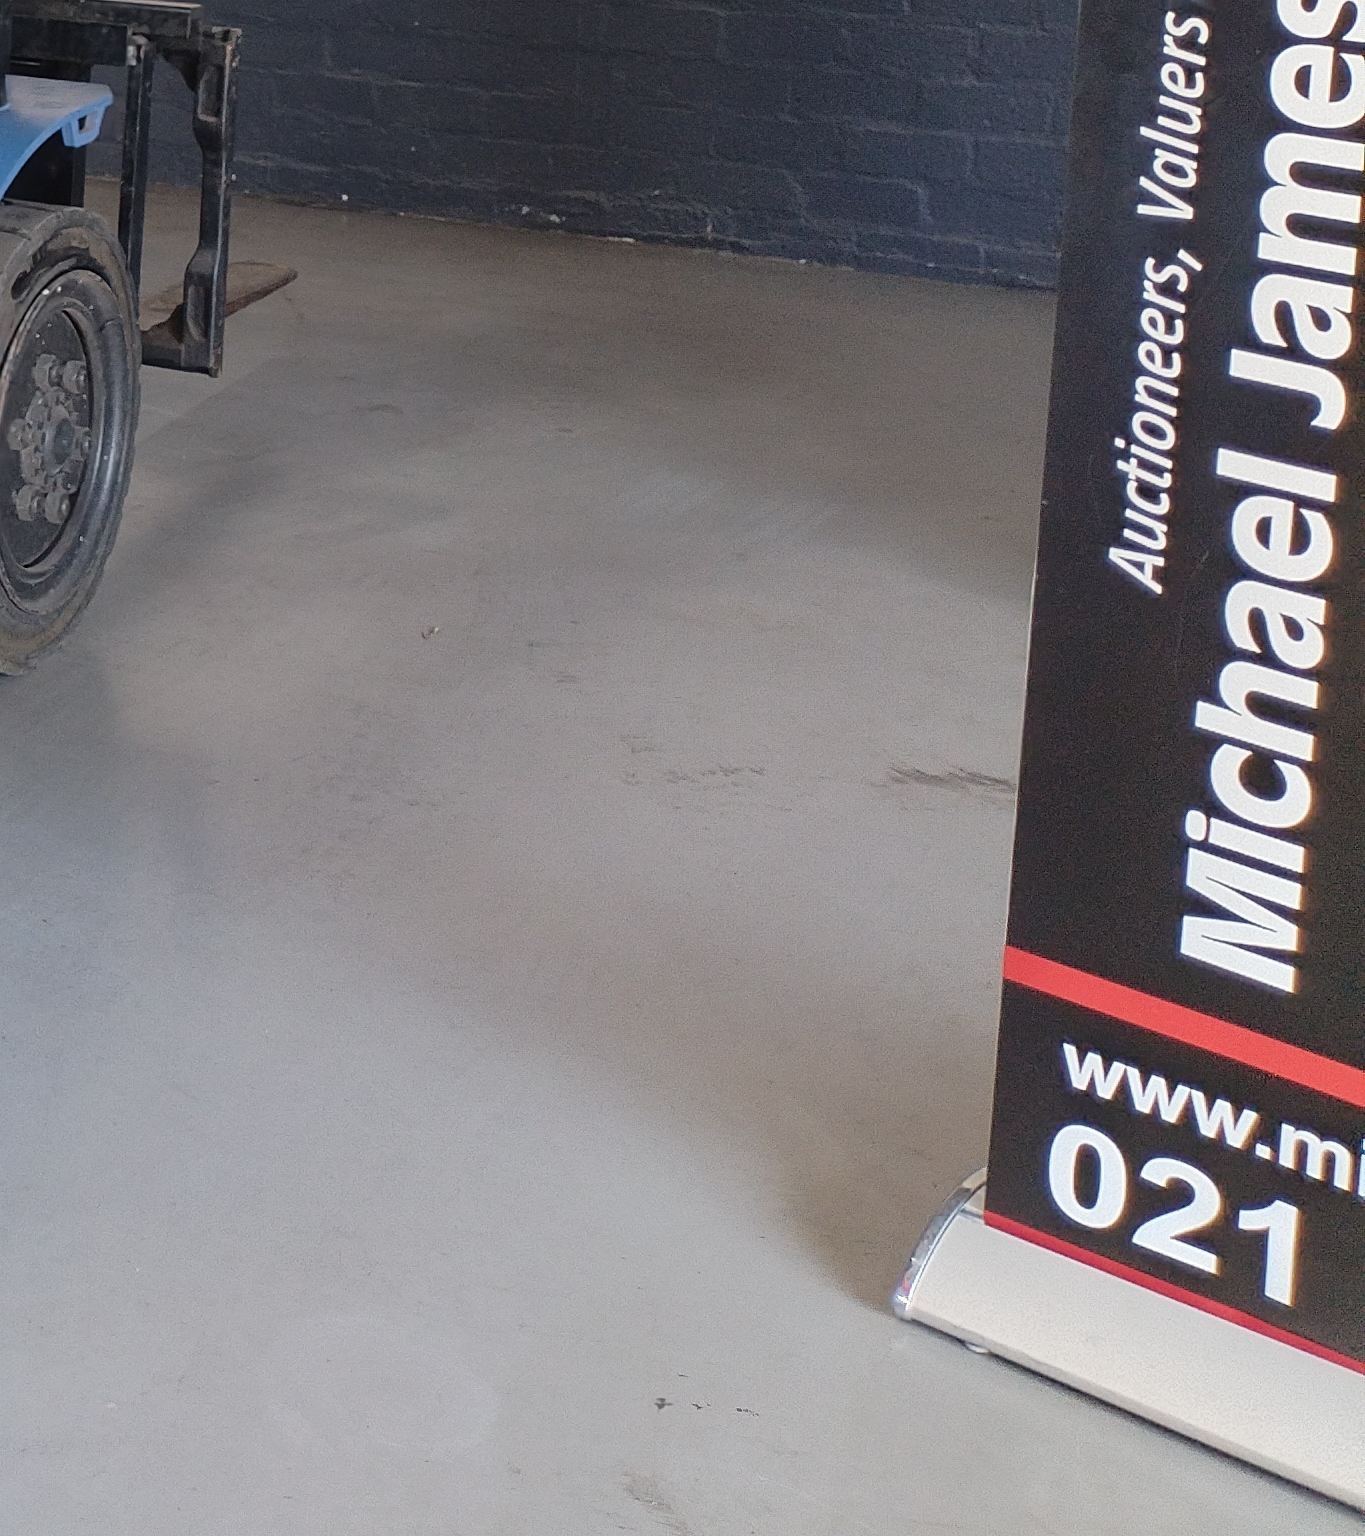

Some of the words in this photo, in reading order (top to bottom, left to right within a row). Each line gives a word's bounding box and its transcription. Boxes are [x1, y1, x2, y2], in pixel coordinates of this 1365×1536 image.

[1136, 11, 1209, 220] Valuers
[1108, 248, 1203, 595] Auctioneers,
[1179, 447, 1338, 994] Michael
[1048, 1124, 1299, 1307] 021
